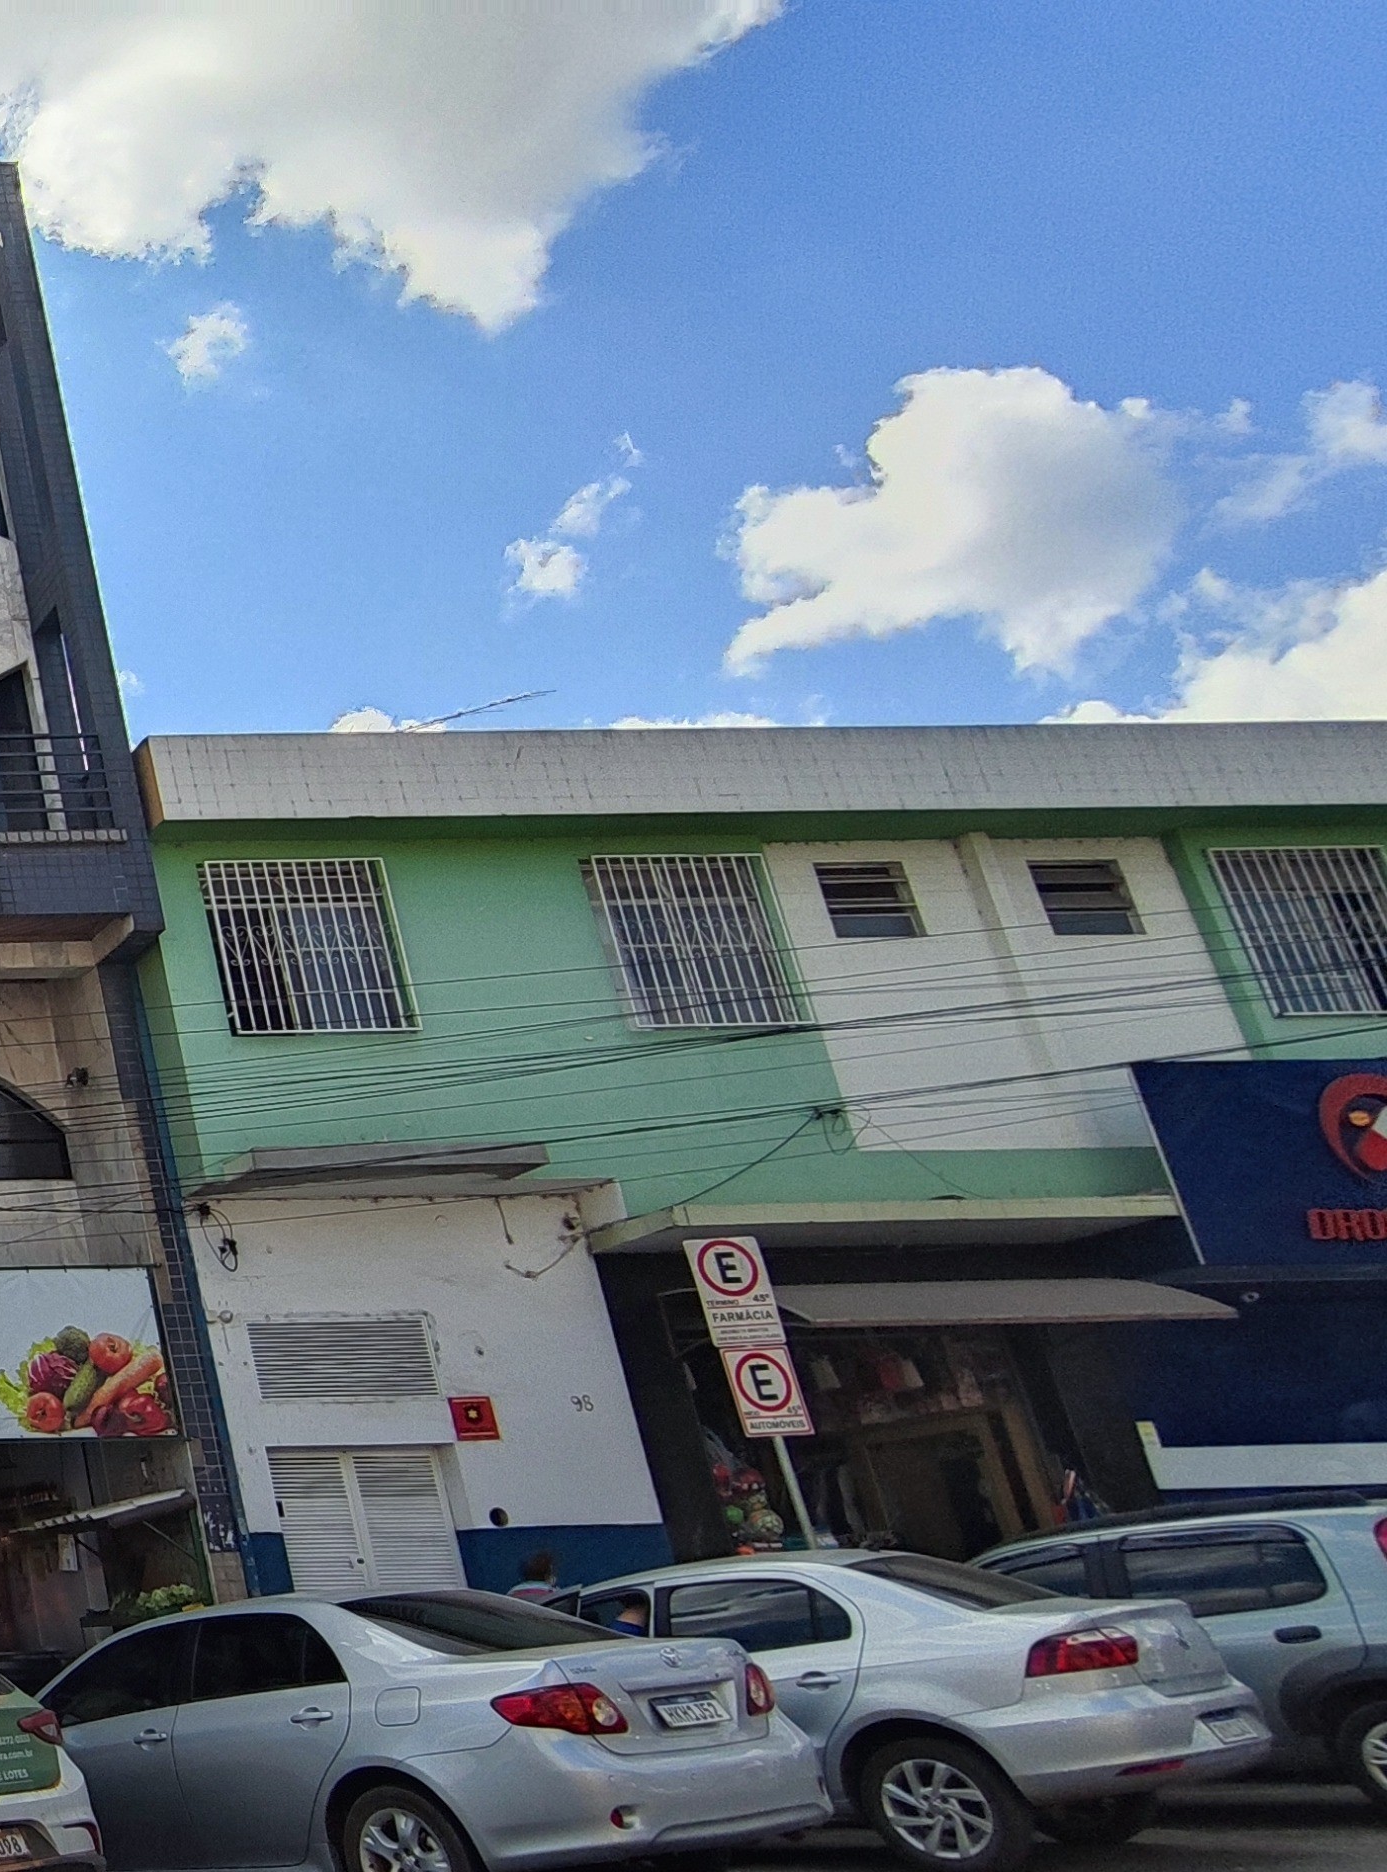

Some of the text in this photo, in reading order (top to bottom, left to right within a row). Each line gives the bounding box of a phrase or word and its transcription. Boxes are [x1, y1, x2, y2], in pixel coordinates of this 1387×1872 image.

[714, 1252, 743, 1284] E
[712, 1309, 774, 1323] FARMÁCIA
[748, 1364, 779, 1401] E
[570, 1394, 595, 1412] 98
[750, 1418, 805, 1430] AUTOMÓVEIS
[2, 1768, 29, 1781] LOTES
